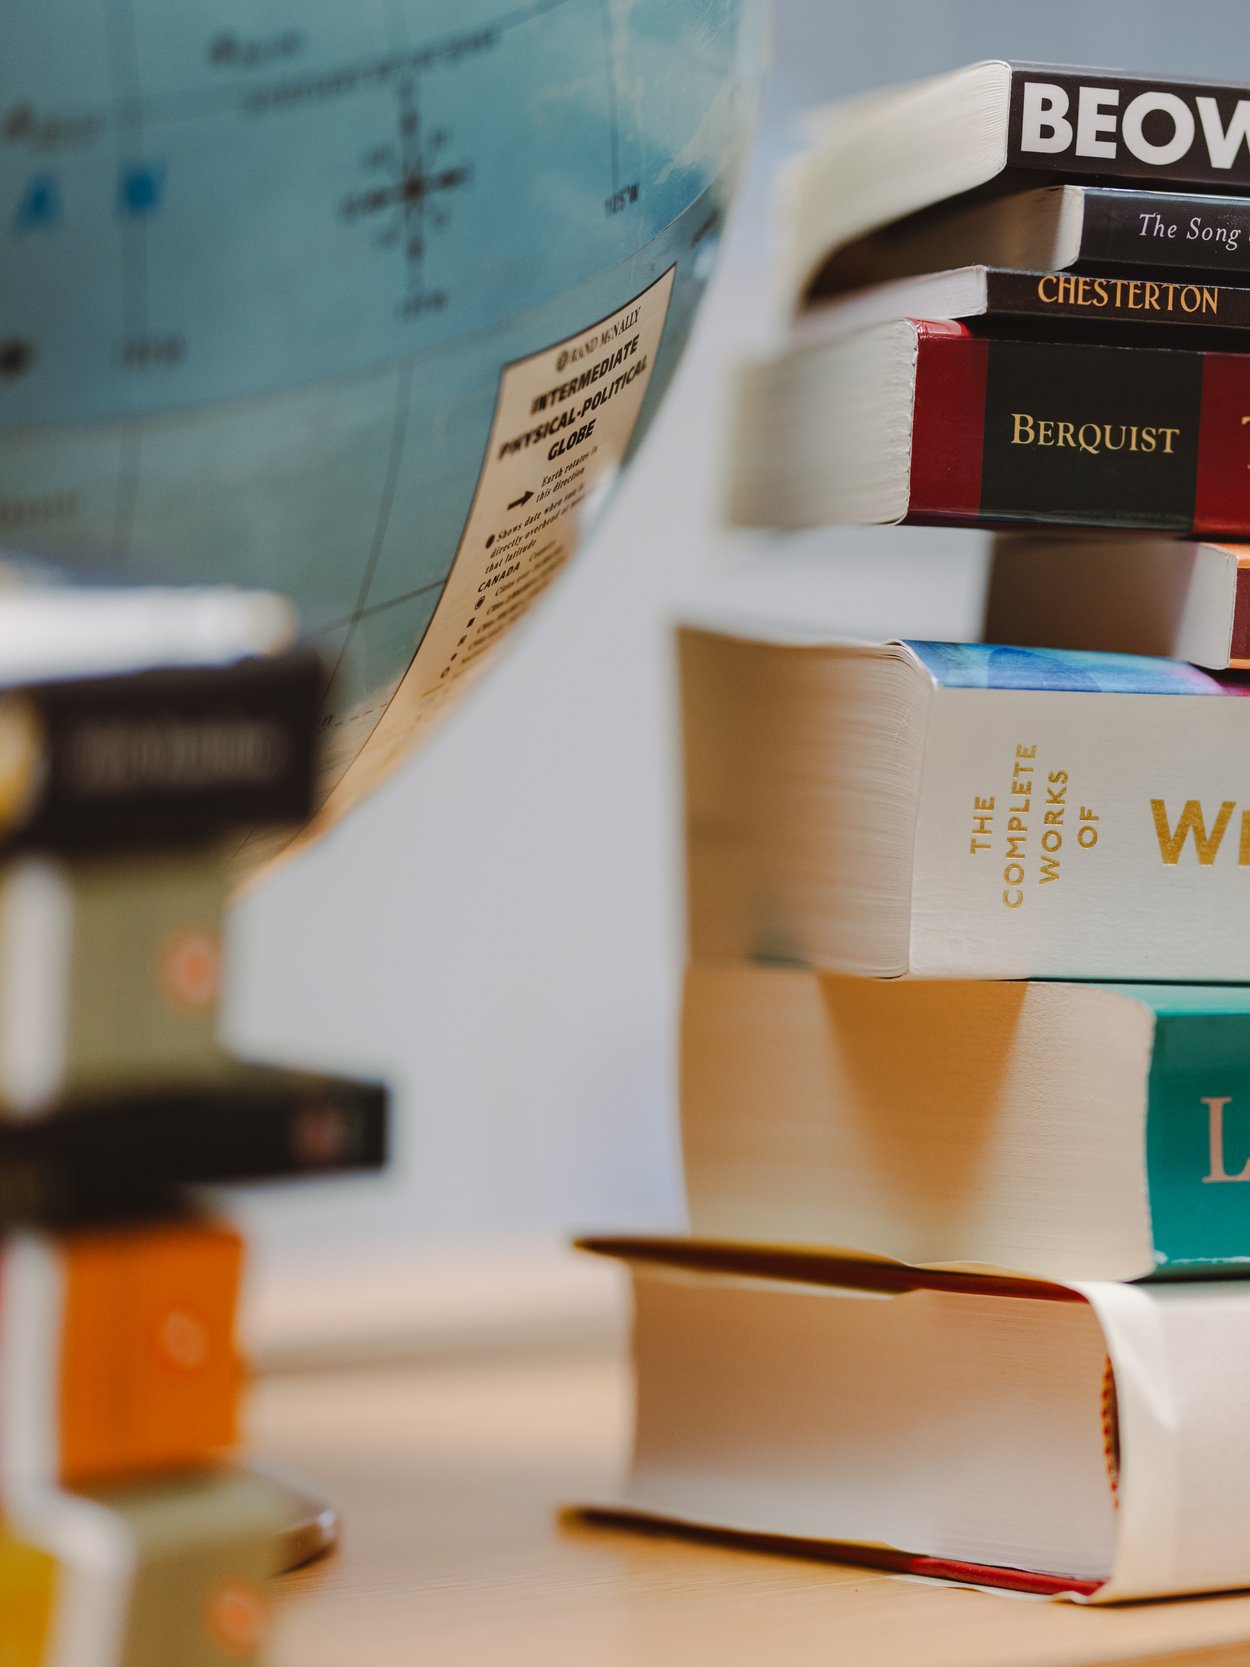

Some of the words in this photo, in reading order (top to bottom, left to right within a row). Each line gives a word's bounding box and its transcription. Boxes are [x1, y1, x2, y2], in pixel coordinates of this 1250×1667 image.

[1138, 213, 1178, 241] The
[1186, 217, 1242, 252] Song
[1037, 275, 1219, 315] CHESTERTON
[530, 334, 640, 415] INTERMEDIATE
[497, 355, 648, 461] PHYSICAL-POLITICAL
[547, 418, 597, 461] GLOBE
[1010, 413, 1180, 455] BERQUIST
[536, 488, 551, 503] this
[552, 467, 585, 493] direction
[541, 467, 563, 487] Earth
[564, 452, 589, 474] rotates
[490, 534, 522, 559] directly
[524, 512, 559, 539] overhead
[496, 523, 522, 542] Shows
[524, 511, 542, 527] date
[544, 499, 562, 514] when
[477, 561, 520, 593] CANADA
[485, 558, 503, 575] that
[504, 539, 537, 564] latitude
[970, 795, 996, 855] THE
[1002, 743, 1038, 910] COMPLETE
[1038, 769, 1069, 886] WORKS
[1077, 805, 1101, 850] OF
